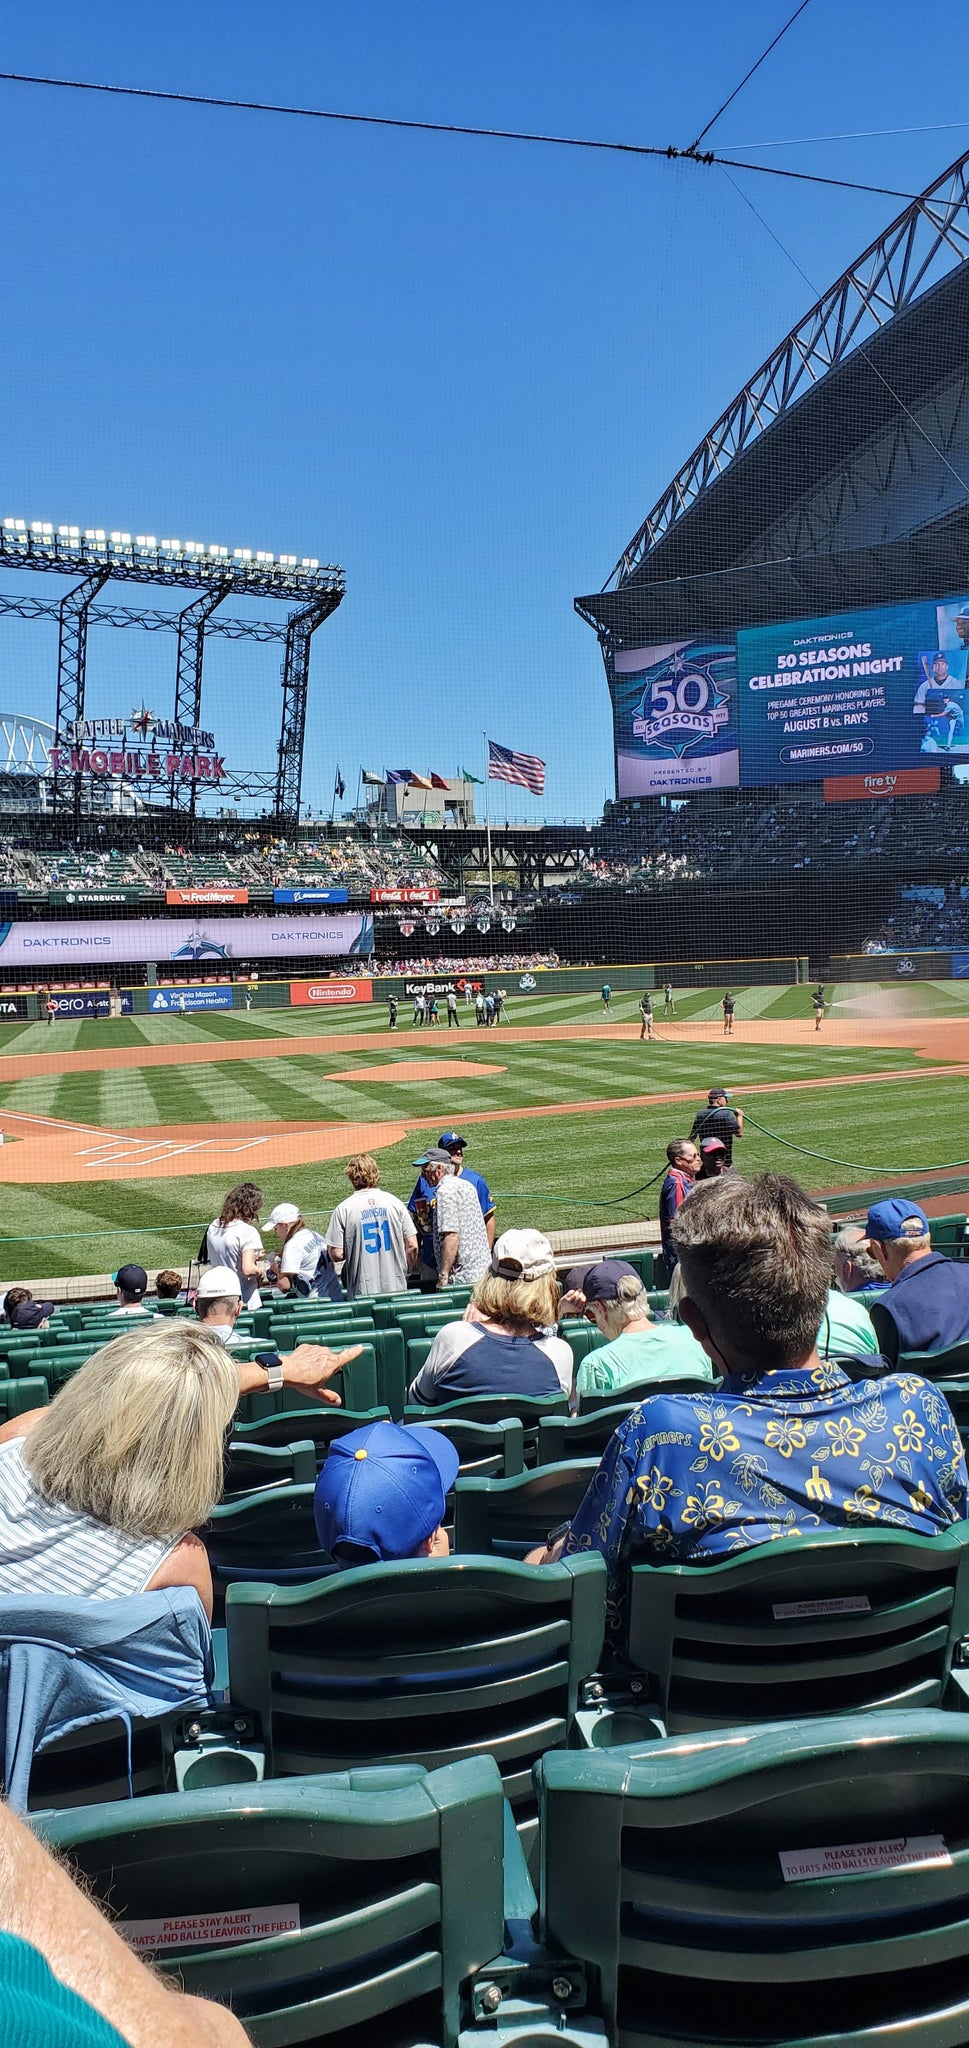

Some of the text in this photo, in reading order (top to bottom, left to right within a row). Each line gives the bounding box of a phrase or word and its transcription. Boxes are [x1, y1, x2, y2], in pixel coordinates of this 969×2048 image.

[793, 632, 854, 646] DAKTRONICS
[777, 643, 872, 669] 50 SEASONS
[749, 656, 903, 690] CELEBRATION NIGHT
[650, 674, 709, 719] 50
[767, 687, 885, 710] PREGAME CEREMONY HONORING THE
[766, 698, 886, 721] TOP 50 GREATEST MARINERS PLAYERS
[646, 714, 710, 735] seasons
[783, 718, 821, 733] AUGUST
[823, 717, 829, 728] 8
[844, 712, 869, 725] RAYS
[66, 718, 215, 749] SEATTLE MARINERS
[790, 742, 863, 759] MARINERS.COM/50
[48, 748, 228, 779] T-MOBILE PARK
[649, 776, 712, 786] DAKTRONICS
[863, 775, 897, 787] fire tv
[78, 894, 126, 902] STARBUCKS
[23, 937, 111, 947] DAKTRONICS
[271, 931, 344, 941] DAKTRONICS
[900, 961, 913, 969] 50
[406, 982, 456, 995] KeyBank
[522, 977, 535, 985] 50
[312, 988, 352, 997] Nintendo
[360, 1207, 387, 1221] JOHNSON
[362, 1220, 391, 1254] 51
[824, 1843, 904, 1861] PLEASE STAY ALERT
[787, 1850, 947, 1876] TO BATS AND BALLS LEAVING THE FIELD
[163, 1913, 252, 1932] PLEASE STAY ALERT
[157, 1933, 178, 1945] AND
[180, 1930, 209, 1942] BALLS
[210, 1925, 251, 1938] LEAVING
[252, 1924, 270, 1934] THE
[271, 1920, 297, 1932] FIELD
